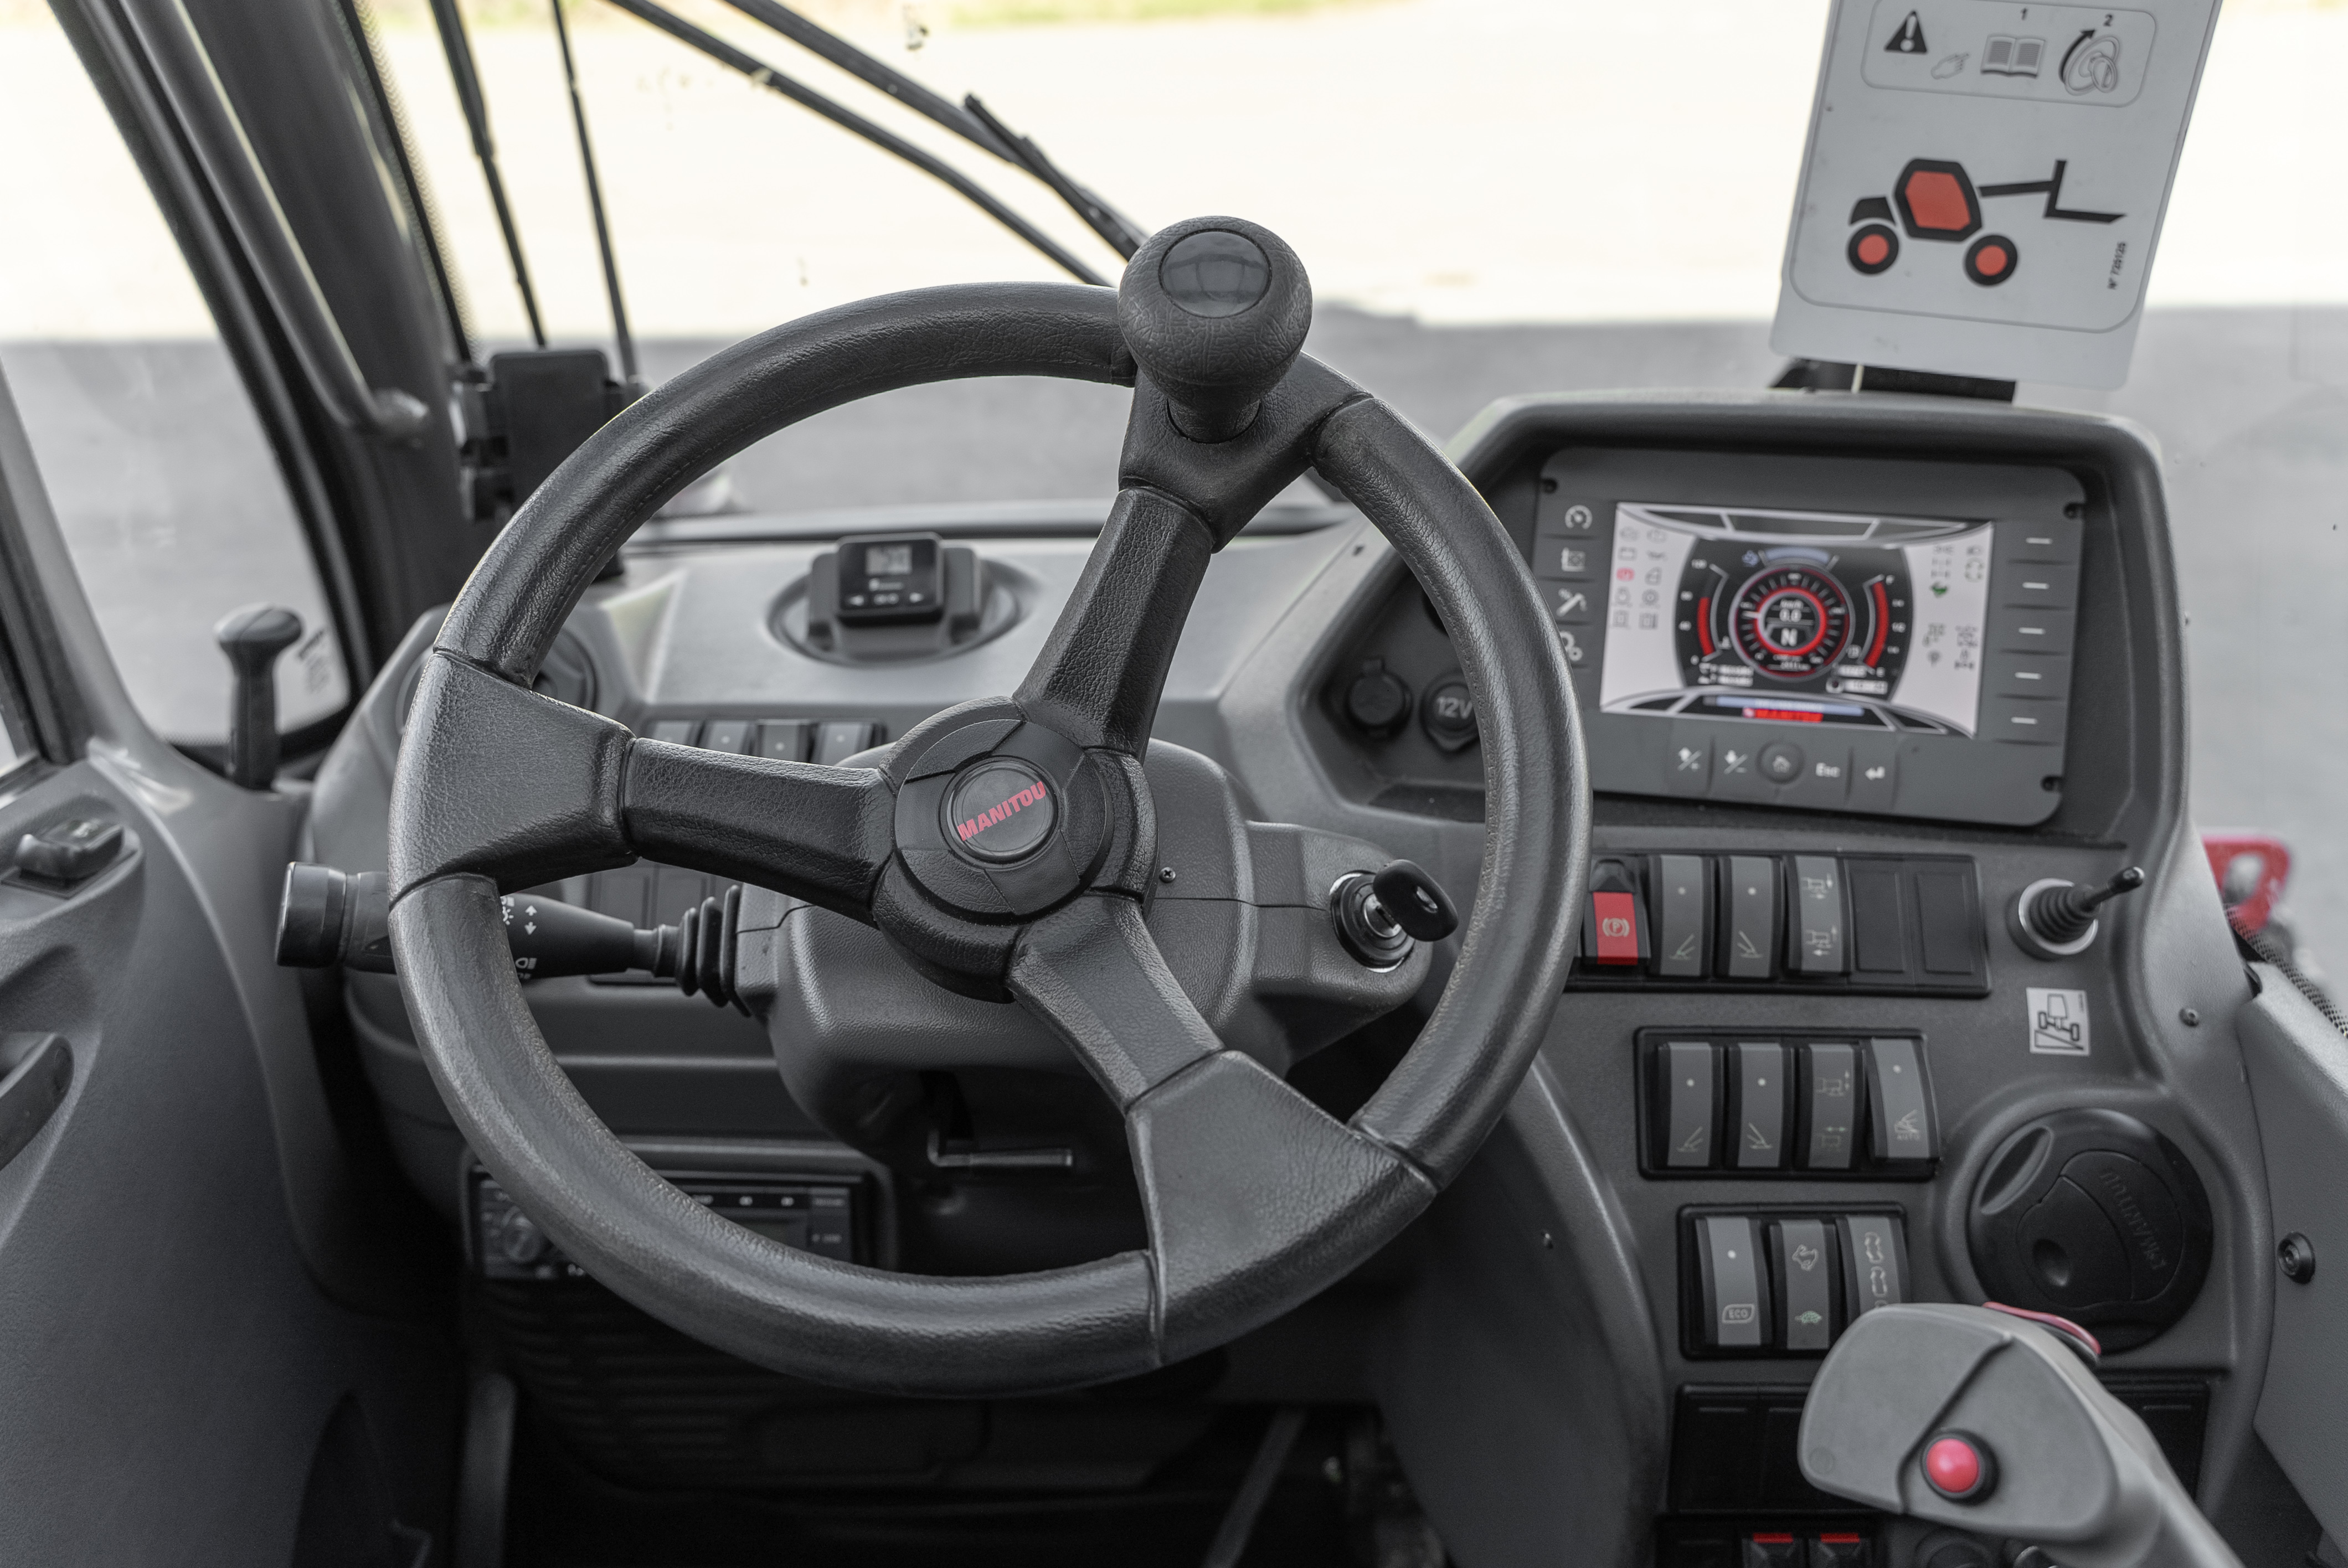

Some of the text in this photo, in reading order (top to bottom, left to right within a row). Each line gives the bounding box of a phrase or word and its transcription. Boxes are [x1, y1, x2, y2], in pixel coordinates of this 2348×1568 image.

[2021, 8, 2028, 20] 1
[2104, 14, 2113, 27] 2
[1780, 628, 1798, 647] N
[1436, 697, 1472, 719] 12V
[1816, 763, 1840, 777] Esc
[957, 781, 1047, 841] MANITOU
[1728, 1309, 1749, 1319] ECO
